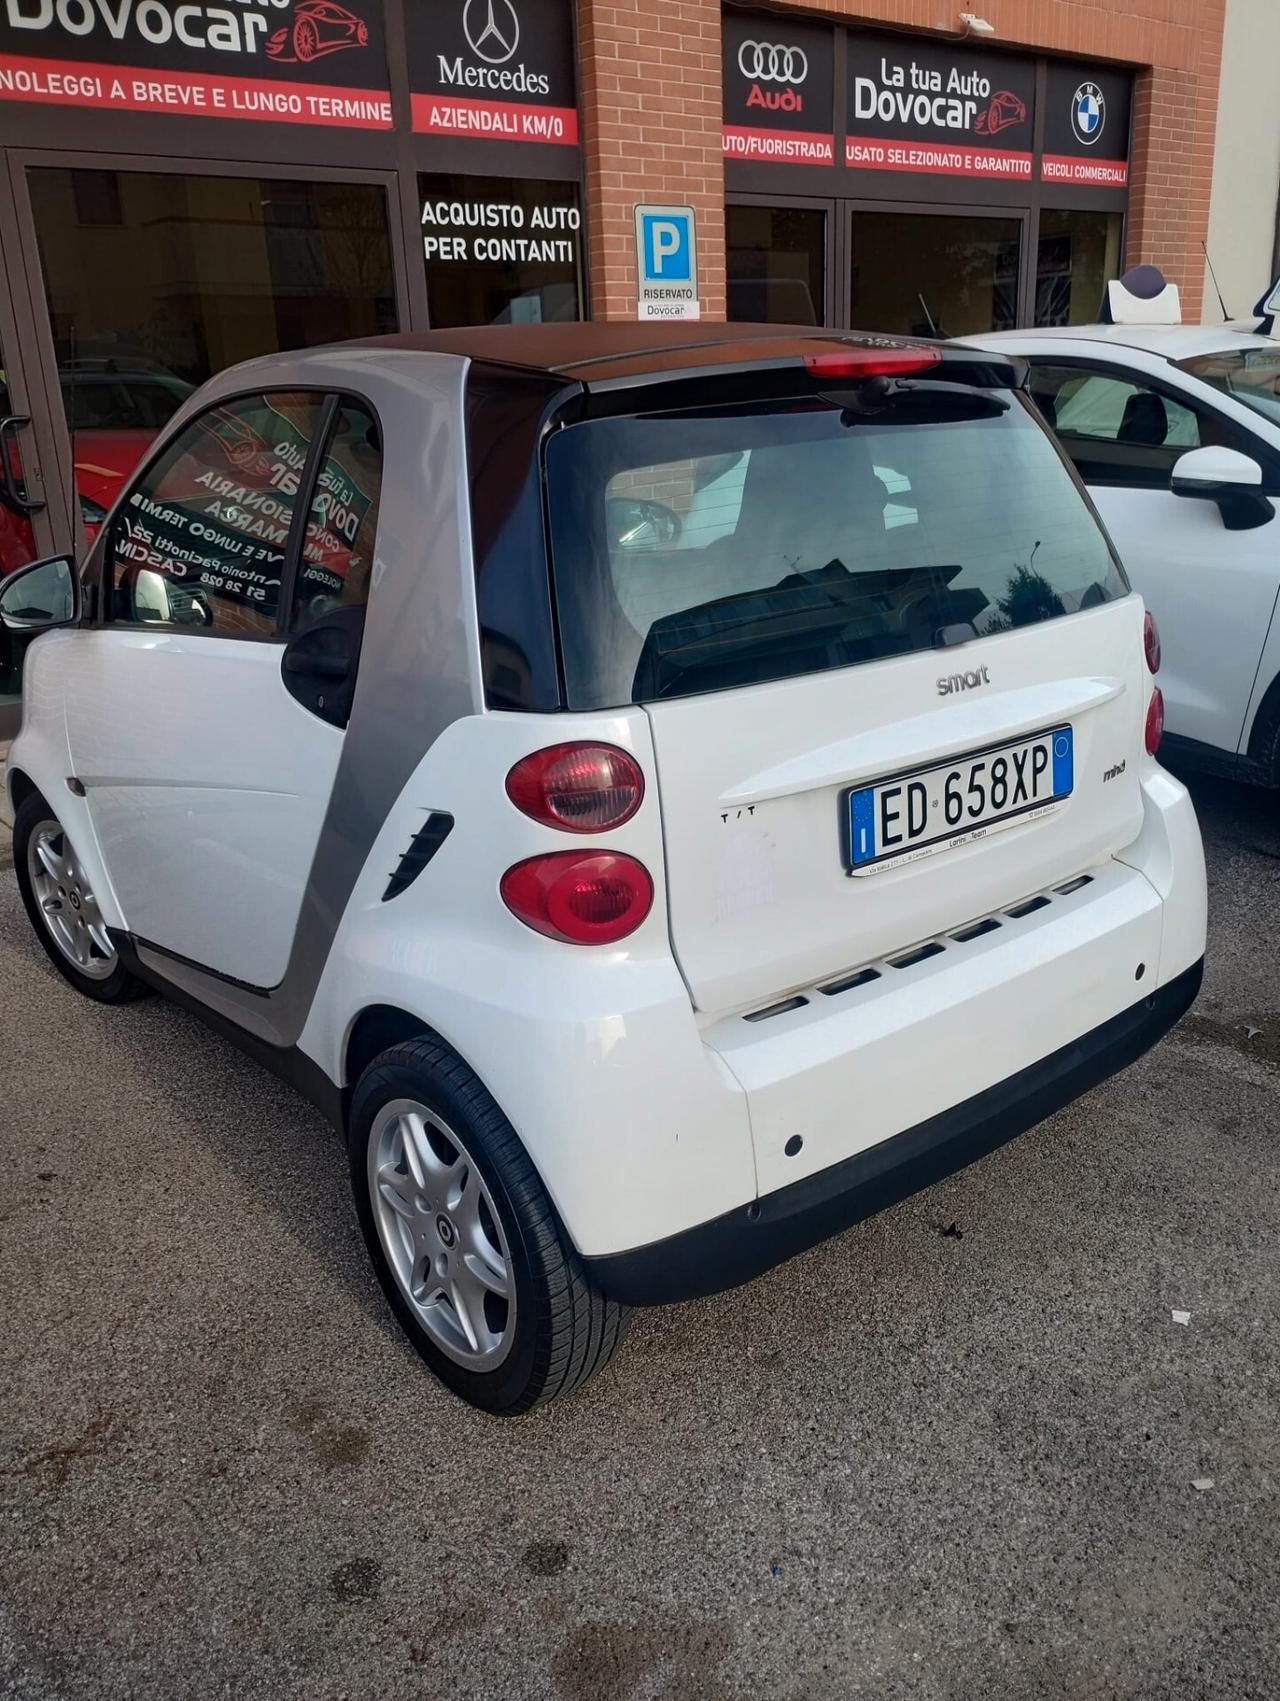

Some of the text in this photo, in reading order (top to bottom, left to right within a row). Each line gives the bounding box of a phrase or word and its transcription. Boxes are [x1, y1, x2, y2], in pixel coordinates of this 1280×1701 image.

[7, 0, 267, 52] Dovocar
[437, 55, 550, 94] Mercedes
[881, 57, 990, 98] La tua Auto
[0, 69, 393, 122] NOLEGGI A BREVE E LUNGO TERMINE
[745, 83, 803, 112] Audi
[855, 77, 977, 130] Dovocar
[430, 106, 564, 139] AZIENDALI KM/0
[846, 146, 1031, 174] USATO SELEZIONATO E GARANTITO
[1042, 162, 1126, 182] VEICOLI COMMERCIALI
[421, 201, 581, 230] ACQUISTO AUTO
[424, 236, 573, 262] PER CONTANTI
[651, 221, 680, 274] P
[644, 288, 693, 299] RISERVATO
[647, 305, 685, 315] Dovocar
[936, 664, 991, 696] smart
[880, 781, 928, 848] ED
[944, 744, 1049, 826] 658XP
